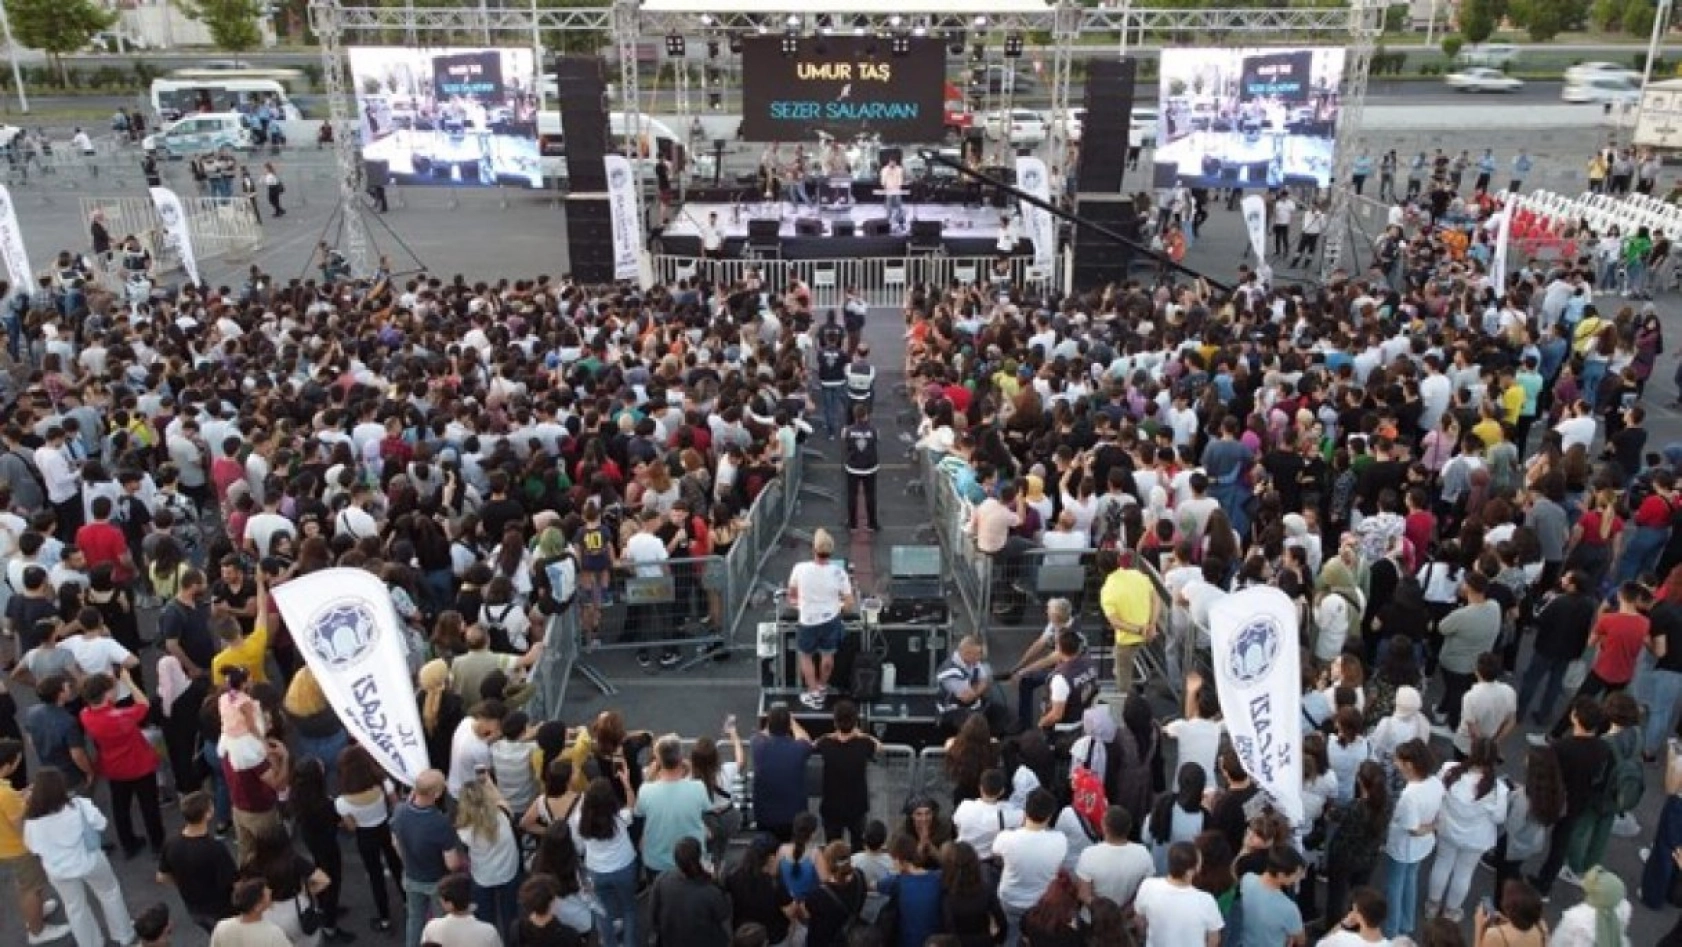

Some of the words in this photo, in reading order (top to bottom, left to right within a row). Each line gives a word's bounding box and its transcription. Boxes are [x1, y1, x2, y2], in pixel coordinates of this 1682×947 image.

[797, 62, 851, 81] UMUR
[857, 62, 891, 83] TAŞ
[770, 102, 820, 118] SEZER
[826, 102, 918, 118] SALARVAN
